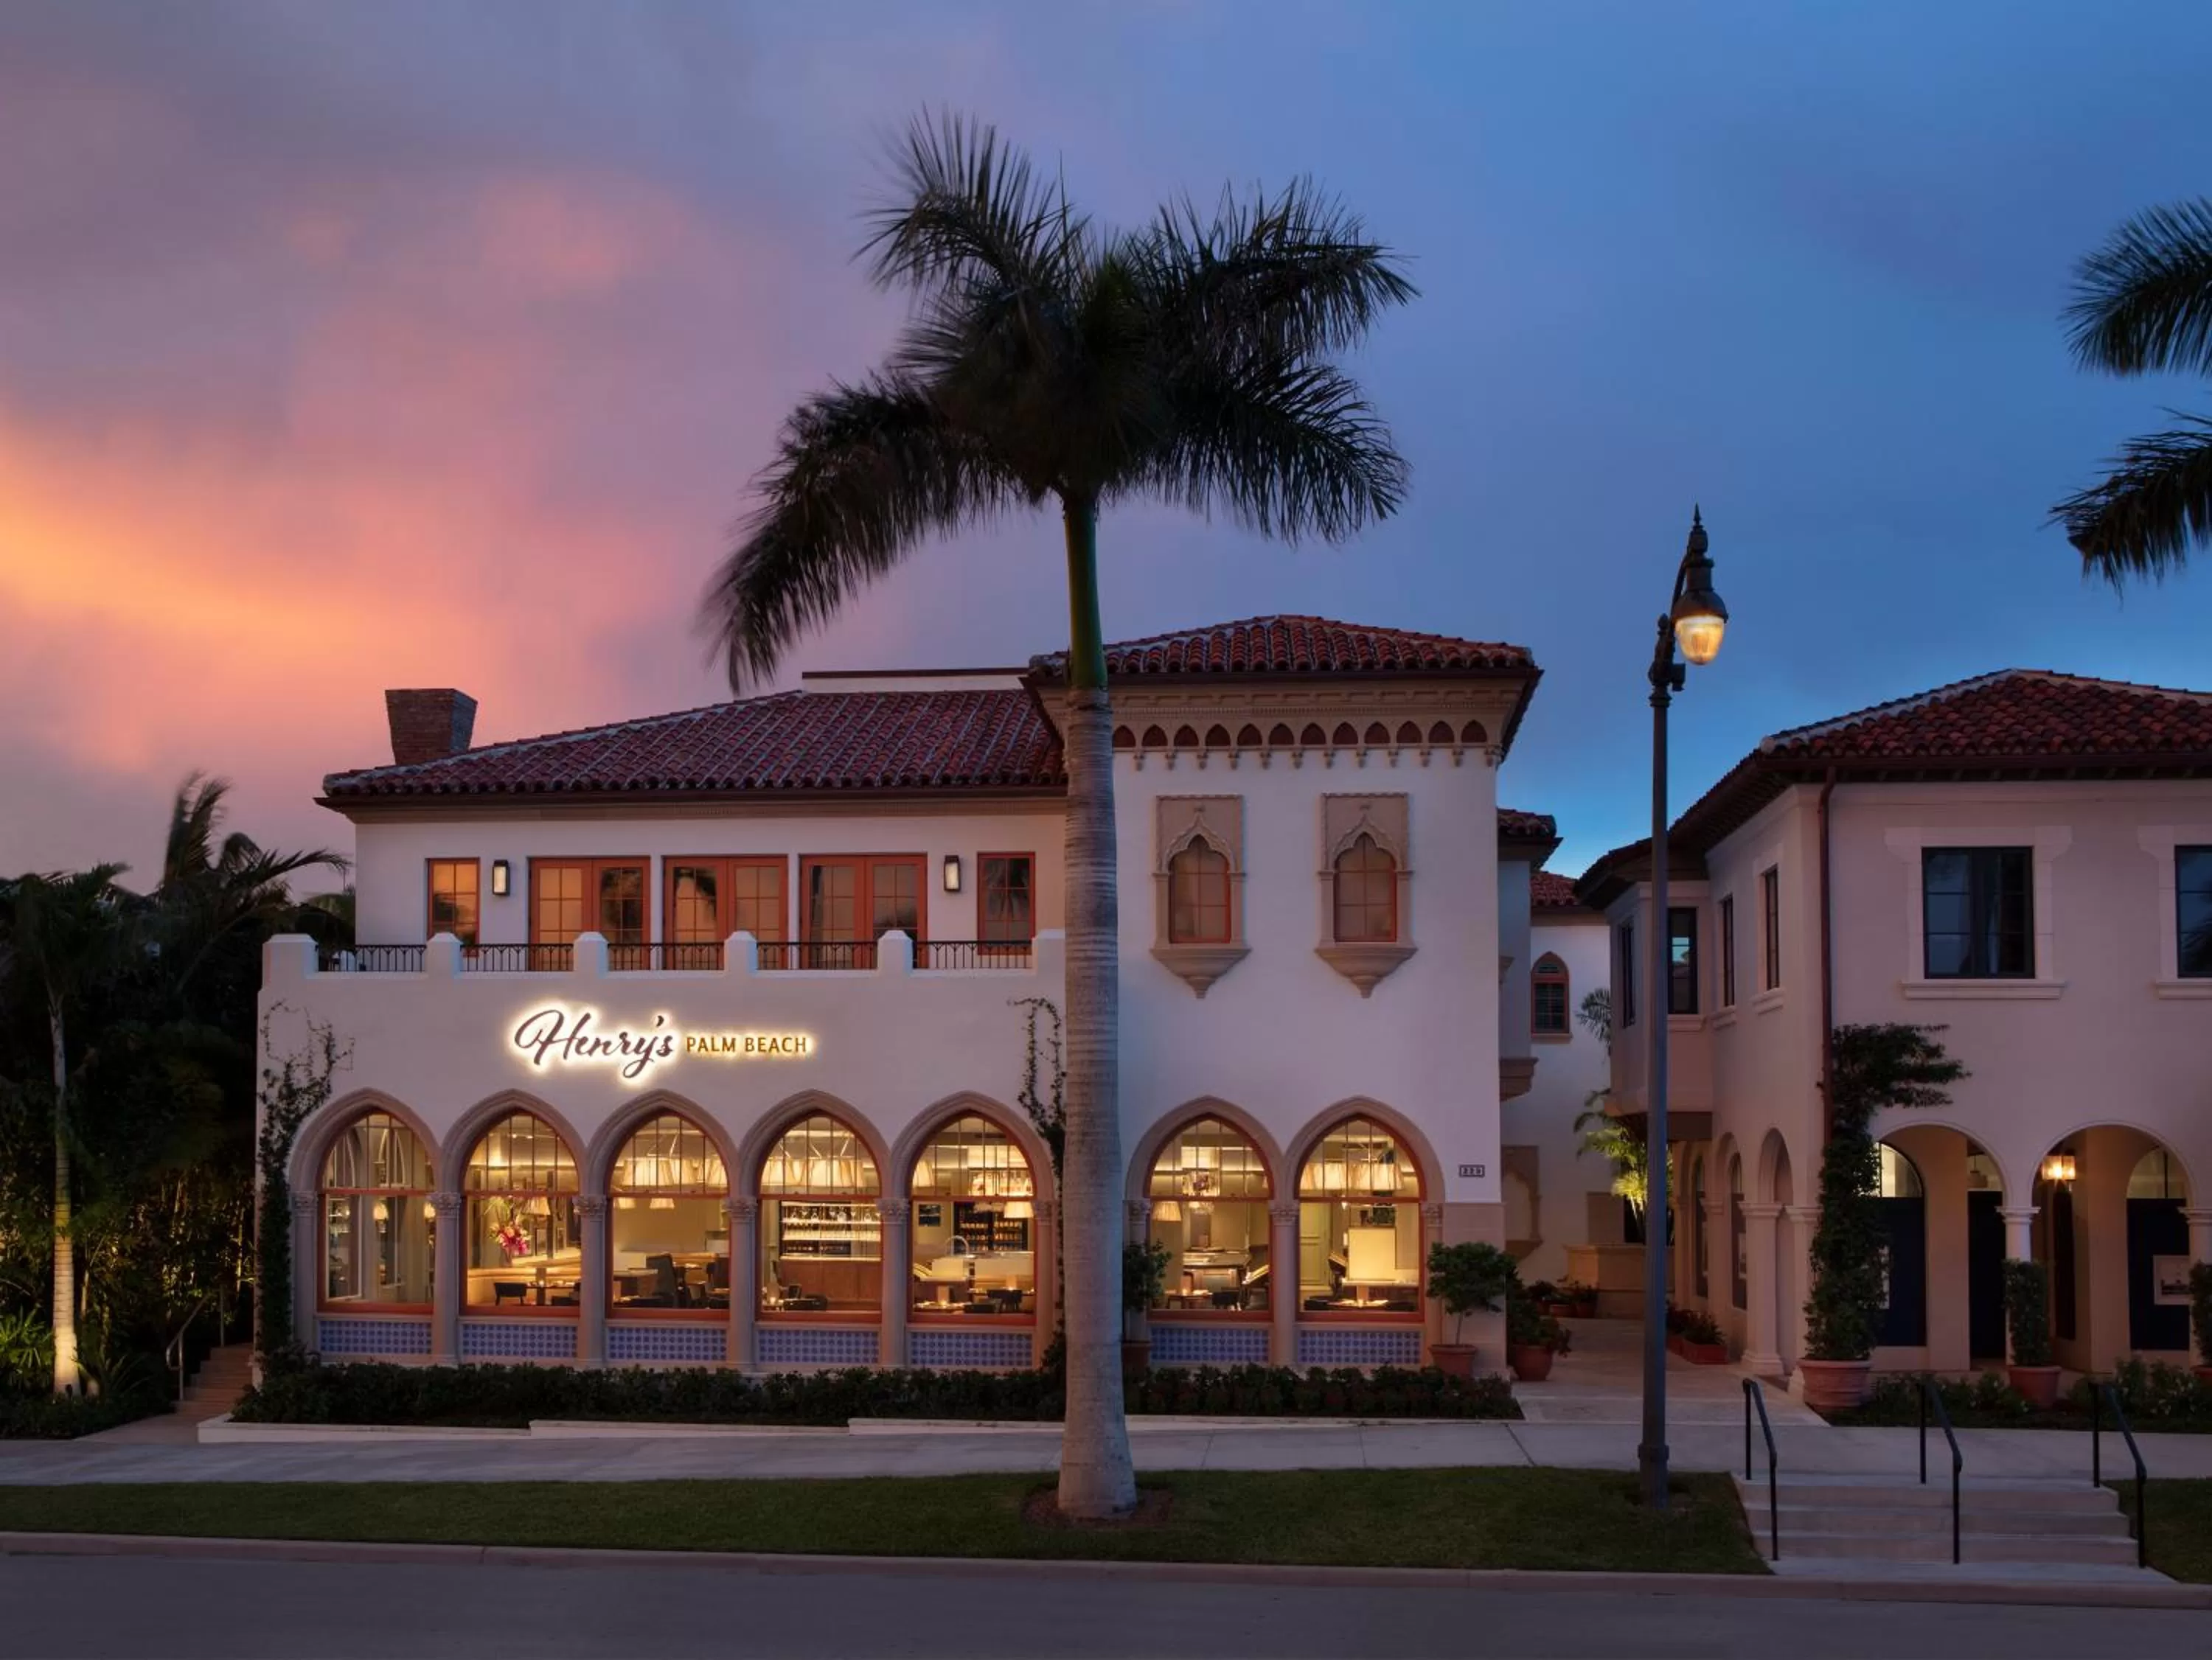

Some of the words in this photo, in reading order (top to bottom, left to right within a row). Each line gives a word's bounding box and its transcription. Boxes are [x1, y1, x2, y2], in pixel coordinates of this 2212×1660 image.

[515, 1010, 673, 1078] Henry's
[686, 1037, 736, 1053] PALM
[745, 1037, 807, 1053] BEACH
